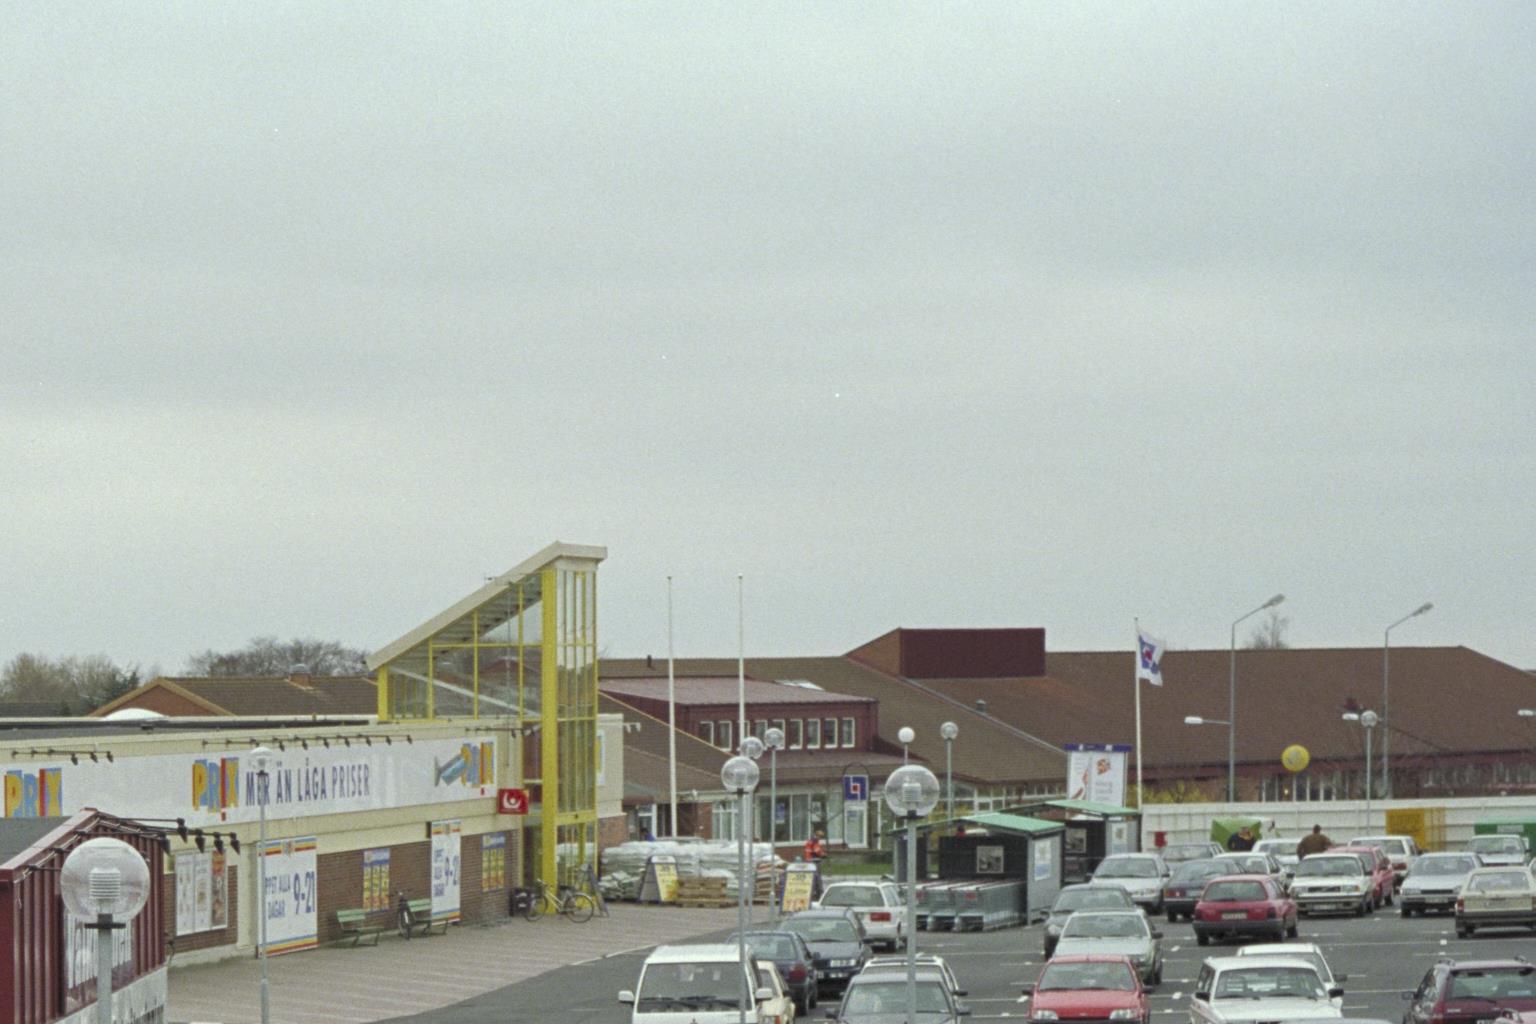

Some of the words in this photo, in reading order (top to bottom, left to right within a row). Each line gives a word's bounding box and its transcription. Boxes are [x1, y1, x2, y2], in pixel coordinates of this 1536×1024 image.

[192, 757, 240, 821] PRIX
[276, 761, 292, 804] ÄN
[298, 757, 327, 801] LÅGA
[332, 763, 370, 798] PRISER
